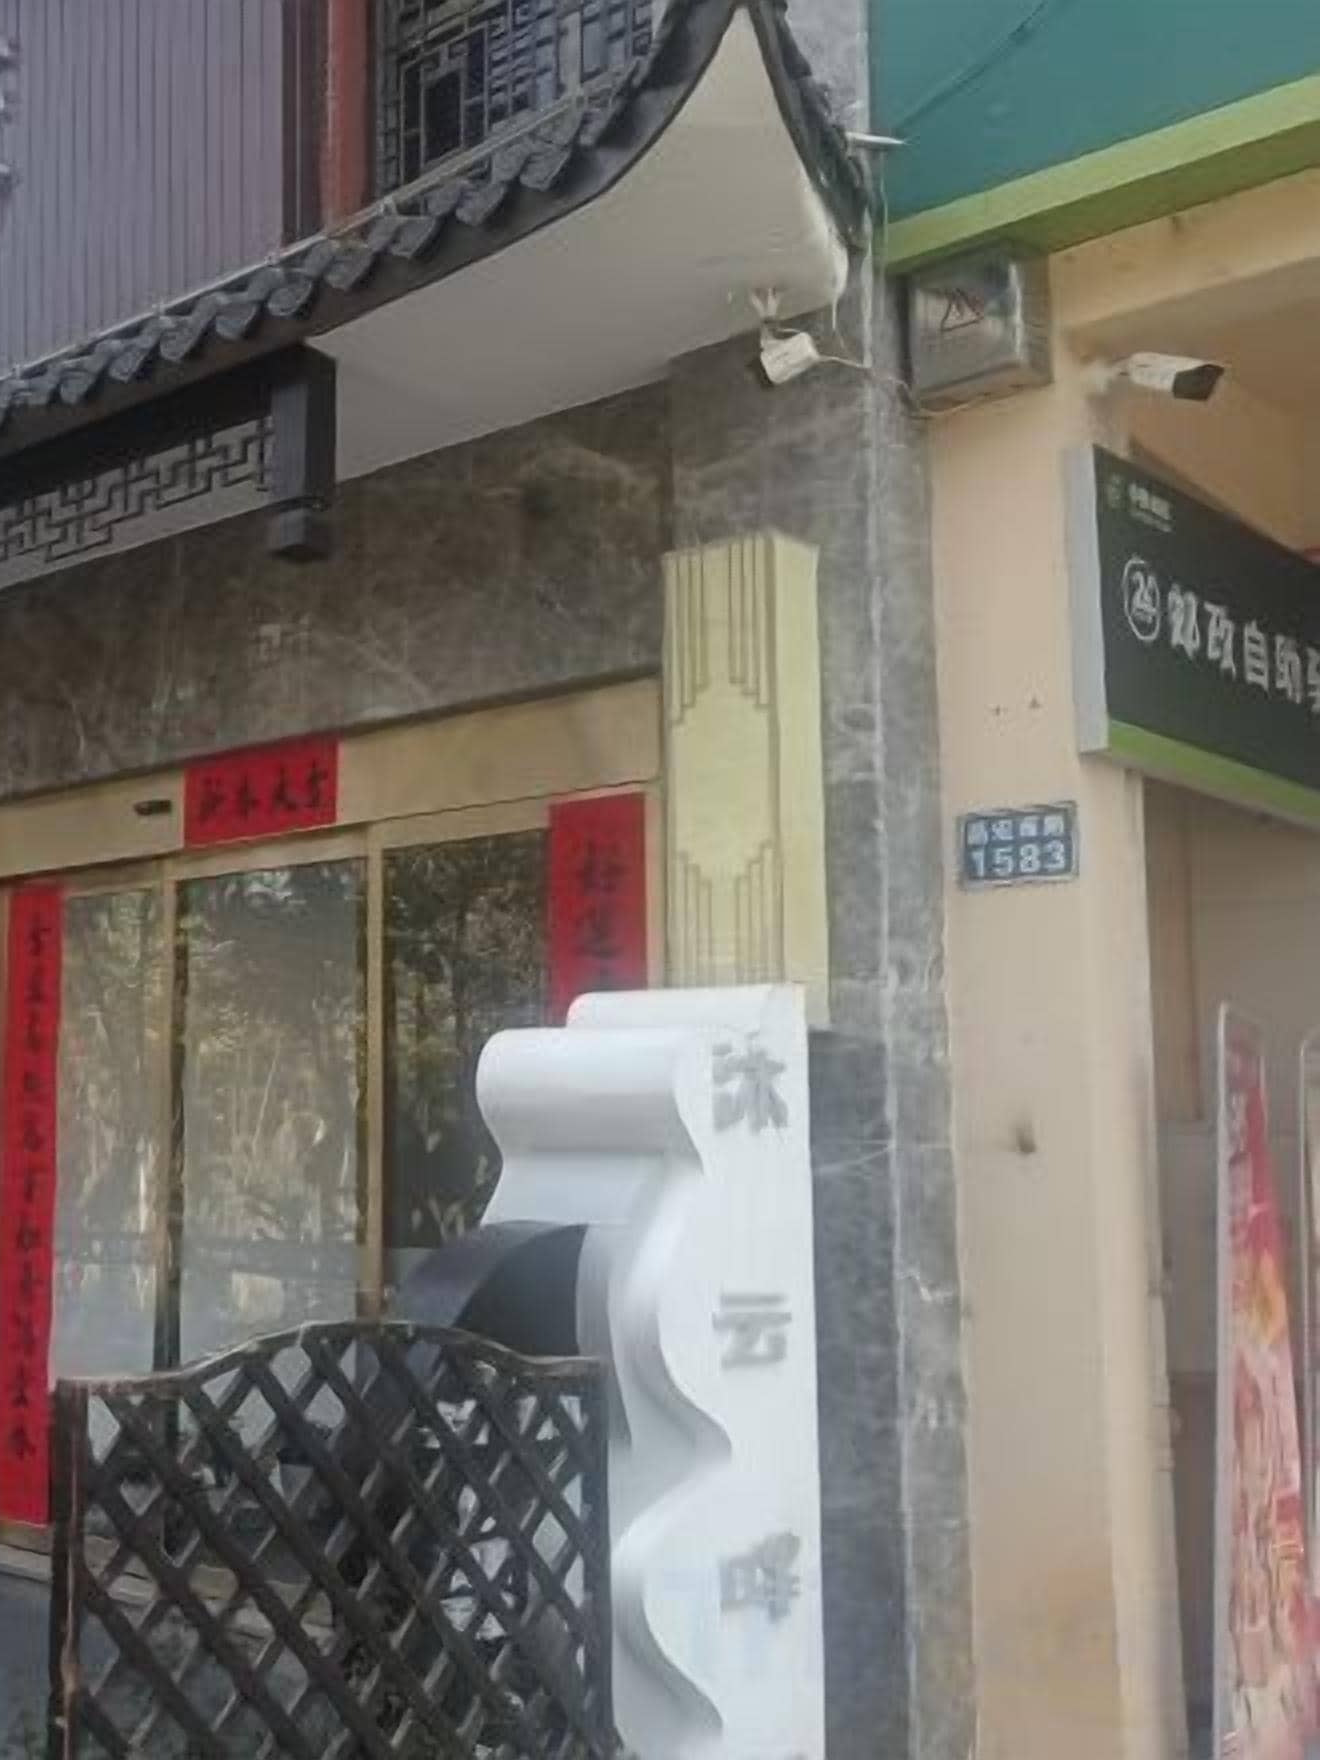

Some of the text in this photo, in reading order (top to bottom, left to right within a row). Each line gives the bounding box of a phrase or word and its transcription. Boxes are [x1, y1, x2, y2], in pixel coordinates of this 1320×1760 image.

[970, 840, 1066, 878] 1583
[711, 1030, 802, 1622] 沐云畔
